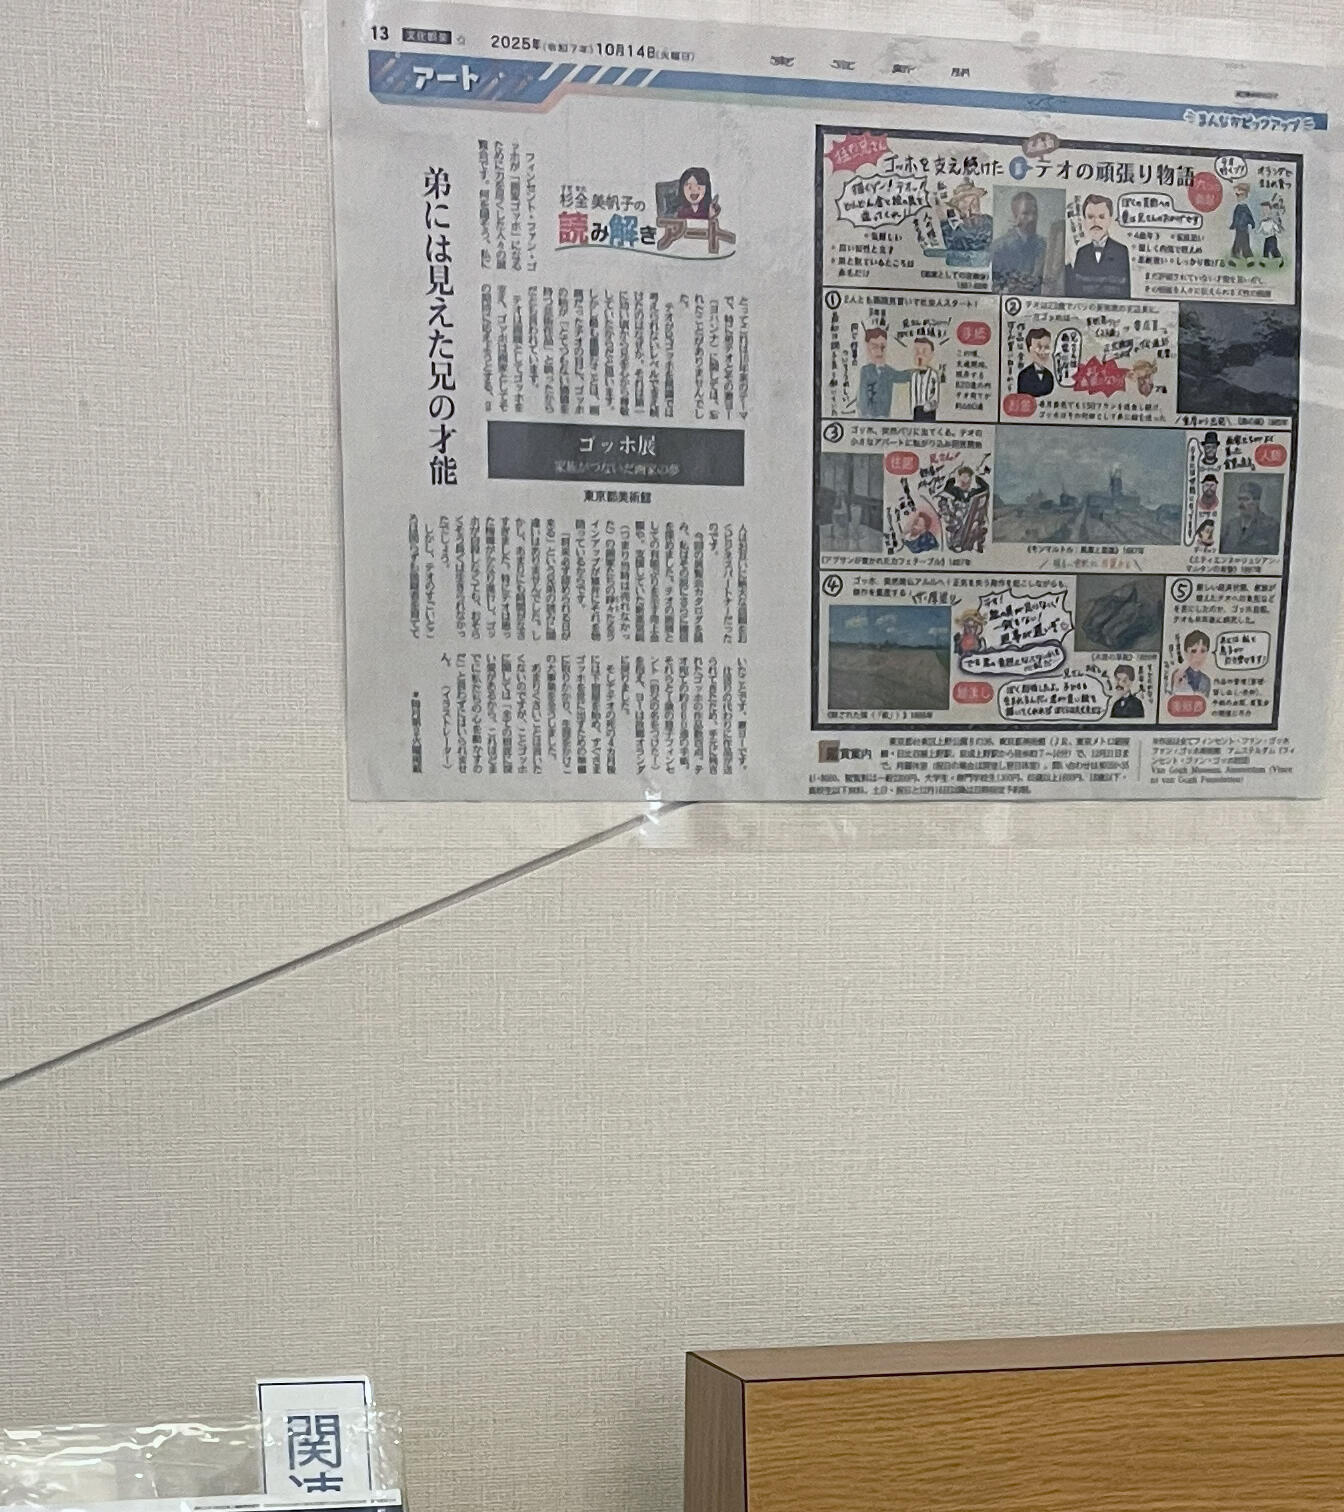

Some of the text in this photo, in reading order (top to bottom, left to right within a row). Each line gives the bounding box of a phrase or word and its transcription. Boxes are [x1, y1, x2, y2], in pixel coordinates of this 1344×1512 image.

[371, 26, 389, 41] 13
[412, 64, 480, 91] アート
[884, 155, 1004, 177] ゴッホを支え続けた
[1035, 160, 1195, 187] テオの頑張り物語
[559, 192, 646, 212] 杉全美帆子の
[558, 211, 736, 255] 読み解きアート
[423, 166, 457, 485] 弟には見えた兄の才能
[579, 434, 656, 457] ゴッホ展
[584, 489, 652, 504] 東京都美術館
